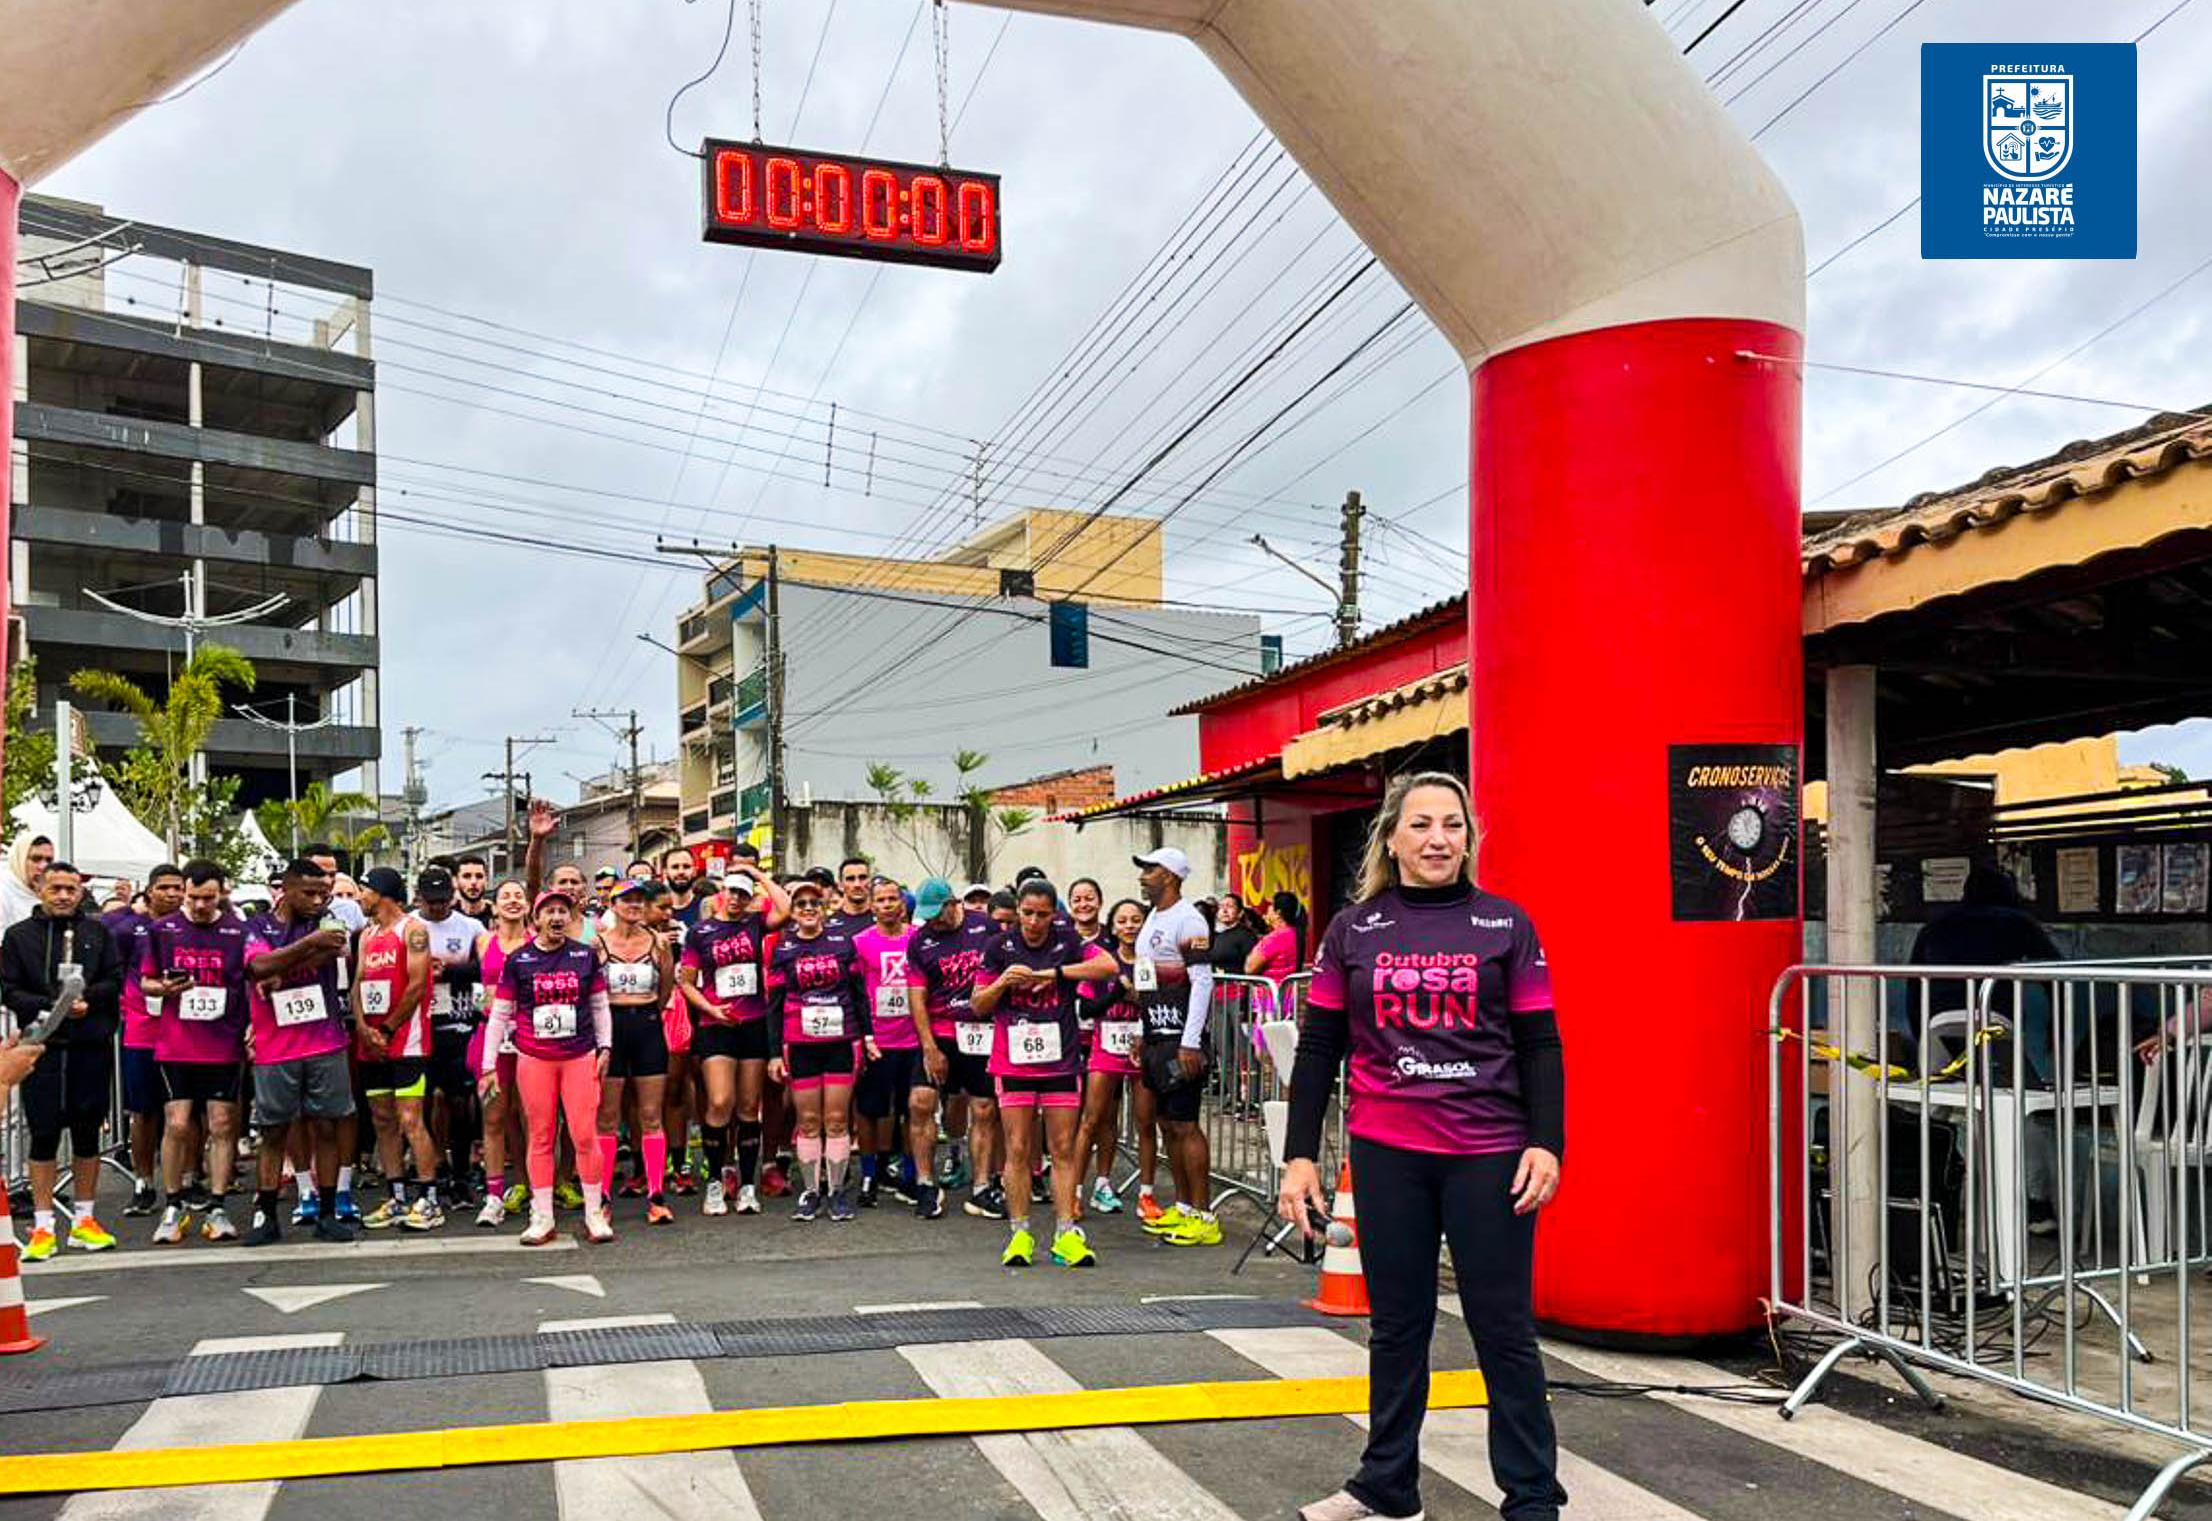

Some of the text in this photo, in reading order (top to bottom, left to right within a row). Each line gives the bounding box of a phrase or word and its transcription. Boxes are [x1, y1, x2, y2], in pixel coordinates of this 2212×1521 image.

[715, 149, 994, 253] 00:00:00
[1375, 951, 1479, 968] Outubro
[618, 973, 638, 986] 98
[729, 975, 746, 988] 38
[1373, 967, 1478, 992] rosa
[189, 998, 217, 1012] 133
[286, 998, 315, 1015] 139
[1373, 993, 1476, 1030] RUN
[967, 1033, 983, 1046] 97
[1024, 1037, 1045, 1052] 68
